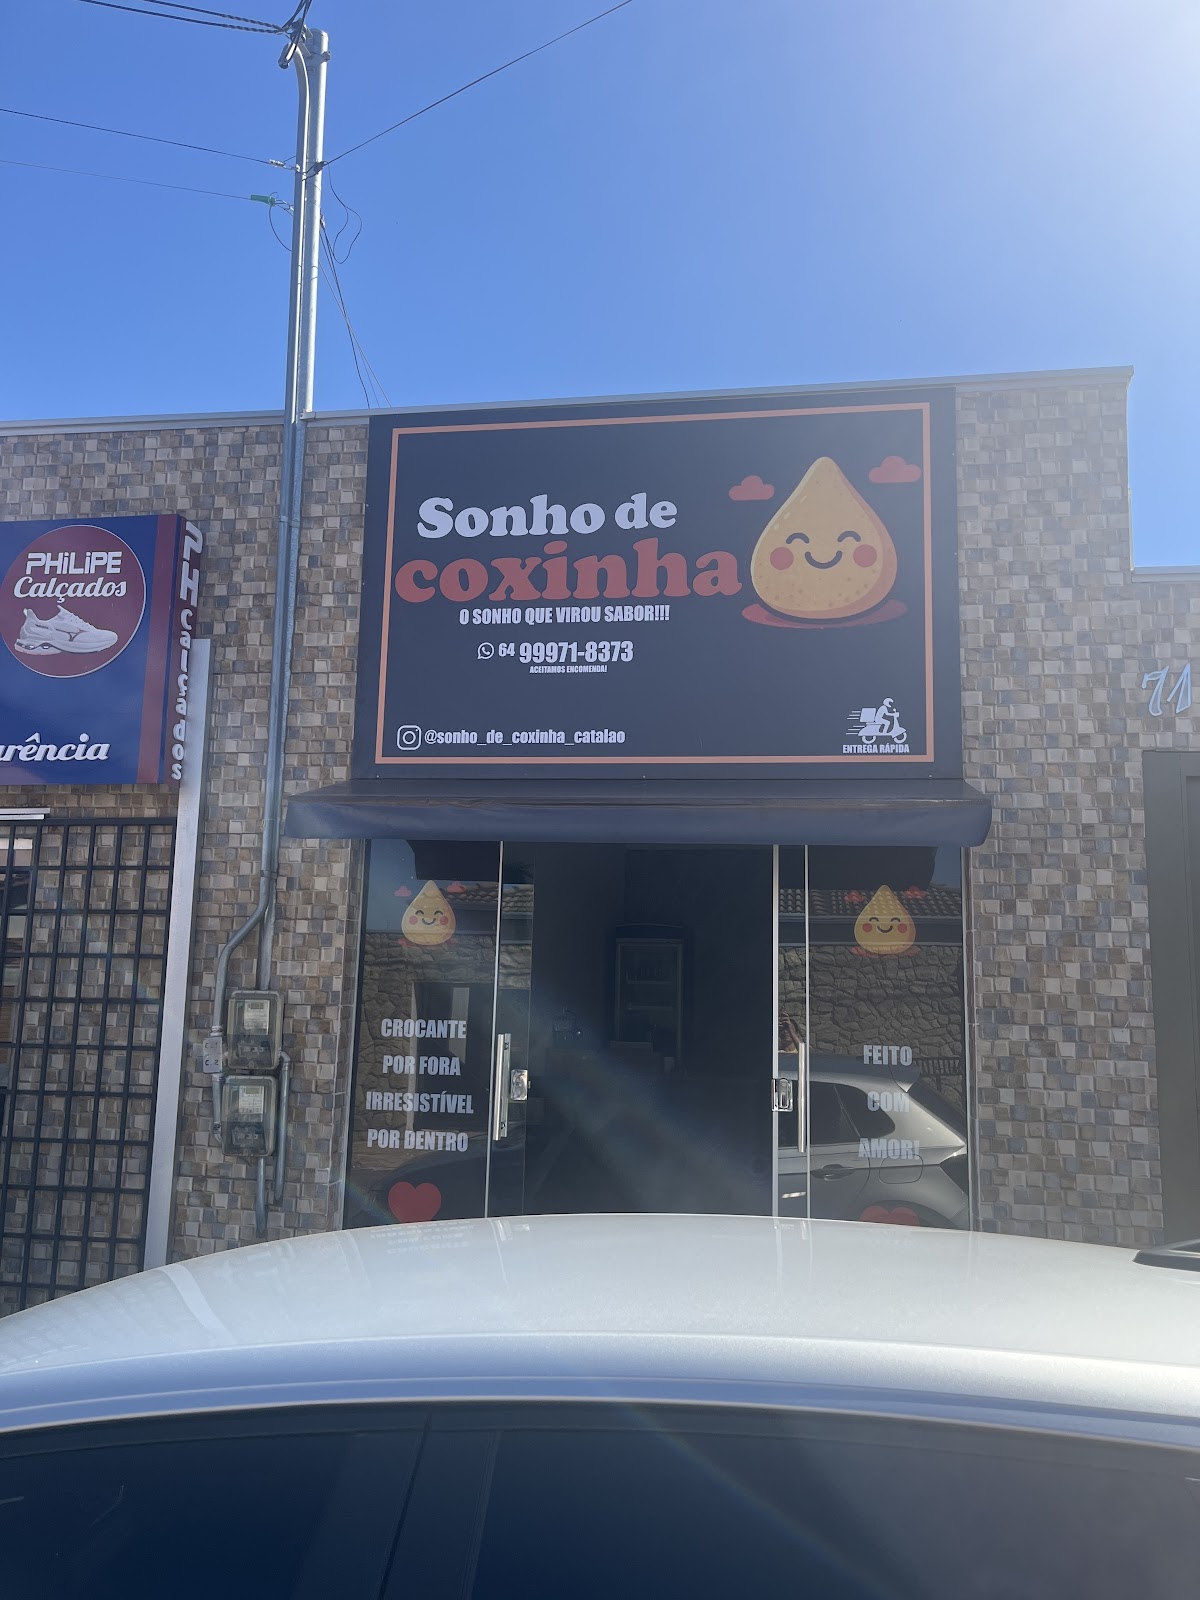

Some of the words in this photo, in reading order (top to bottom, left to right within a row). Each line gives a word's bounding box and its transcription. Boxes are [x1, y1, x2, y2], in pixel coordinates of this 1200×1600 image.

[417, 494, 606, 538] Sonho
[614, 492, 678, 529] de
[395, 537, 743, 602] coxinha
[13, 576, 127, 604] Calçados
[459, 609, 469, 624] O
[472, 608, 521, 625] SONHO
[524, 607, 553, 625] QUE
[556, 606, 601, 623] VIROU
[604, 604, 670, 622] SABOR!!!
[498, 642, 515, 657] 64
[519, 640, 634, 664] 99971-8373
[529, 665, 566, 674] ACEITAMOS
[566, 664, 608, 673] ENCOMENDA!
[0, 732, 111, 762] rência
[424, 728, 626, 746] @sonho_de_coxinha_catalao
[842, 744, 878, 754] ENTREGA
[879, 742, 910, 753] RÁPIDA
[380, 1018, 467, 1039] CROCANTE
[382, 1054, 416, 1075] POR
[418, 1055, 461, 1076] FORA
[863, 1044, 913, 1067] FEITO
[365, 1090, 474, 1114] IRRESISTÍVEL
[867, 1090, 910, 1113] COM
[366, 1128, 400, 1149] POR
[403, 1130, 469, 1152] DENTRO
[858, 1137, 920, 1160] AMOR!
